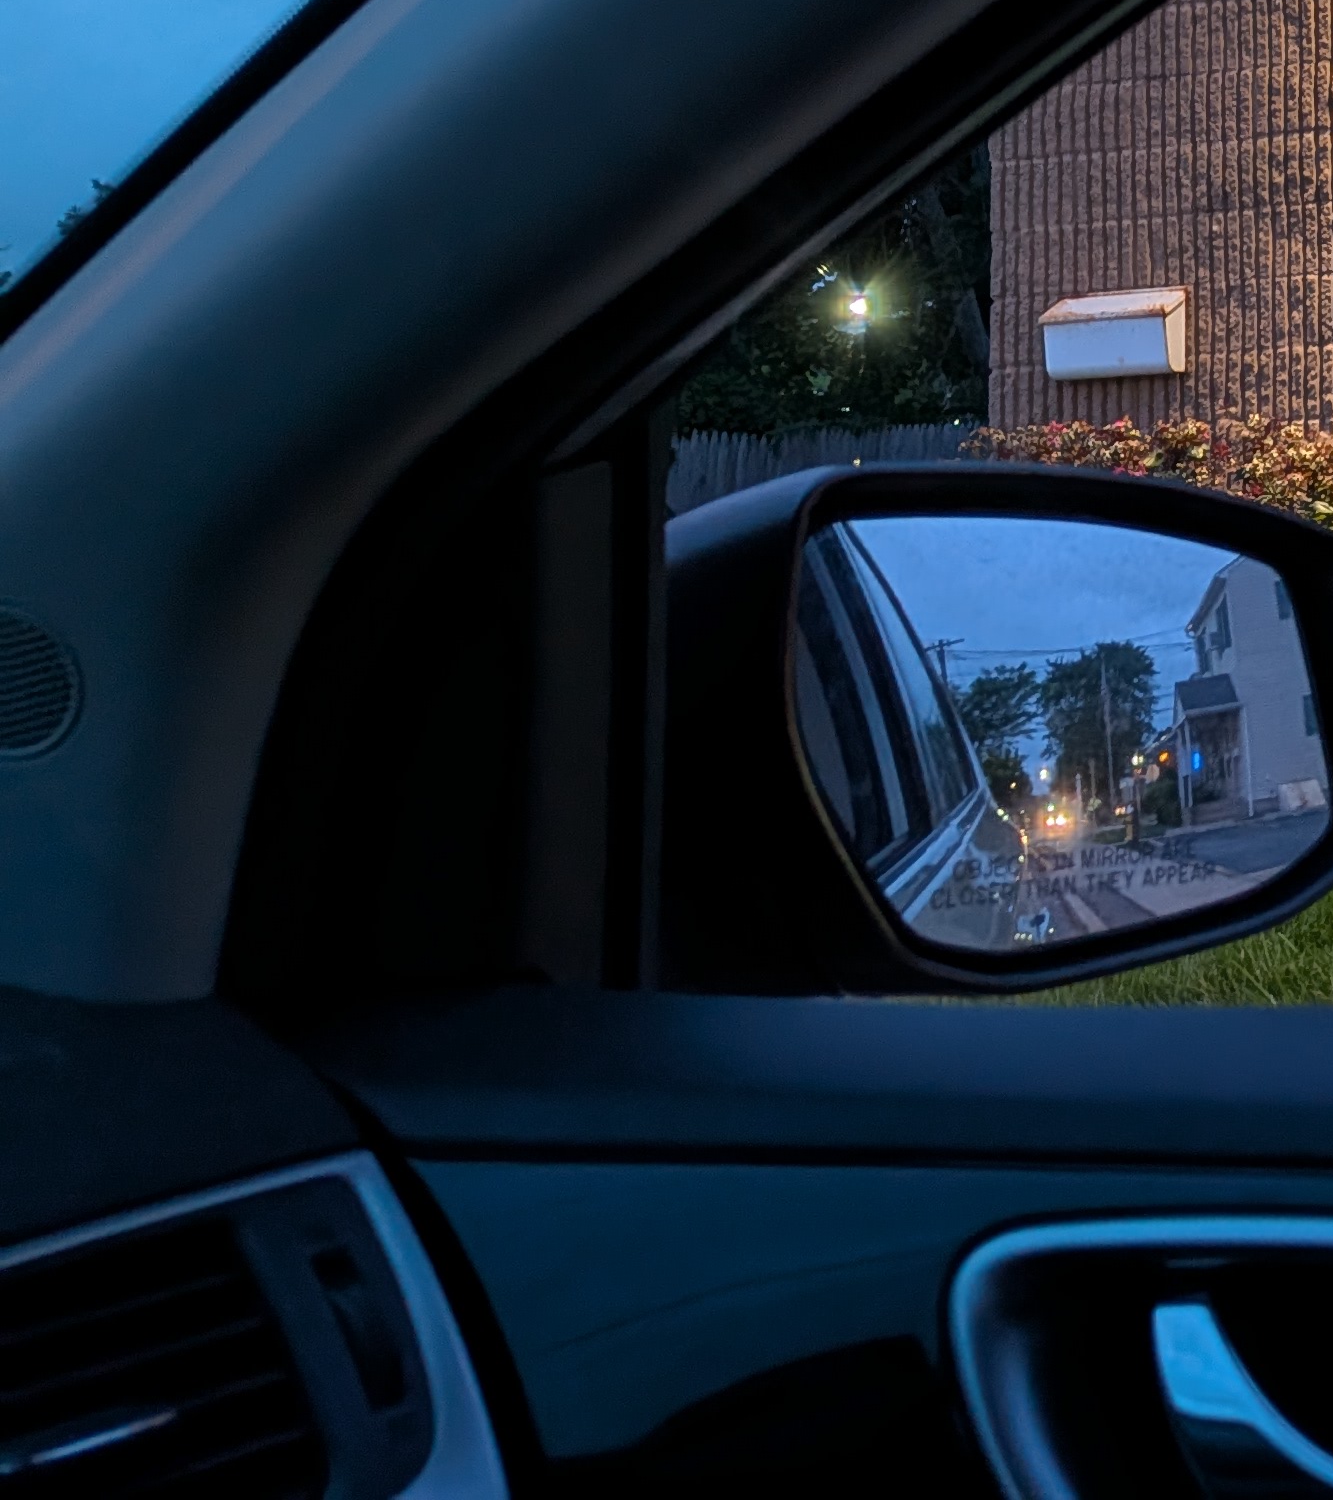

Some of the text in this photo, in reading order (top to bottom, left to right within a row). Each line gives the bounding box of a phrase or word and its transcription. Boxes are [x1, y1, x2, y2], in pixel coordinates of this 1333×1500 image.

[1080, 841, 1155, 868] MIRROR
[1026, 874, 1077, 899] THAN
[1143, 861, 1216, 886] APPEAR
